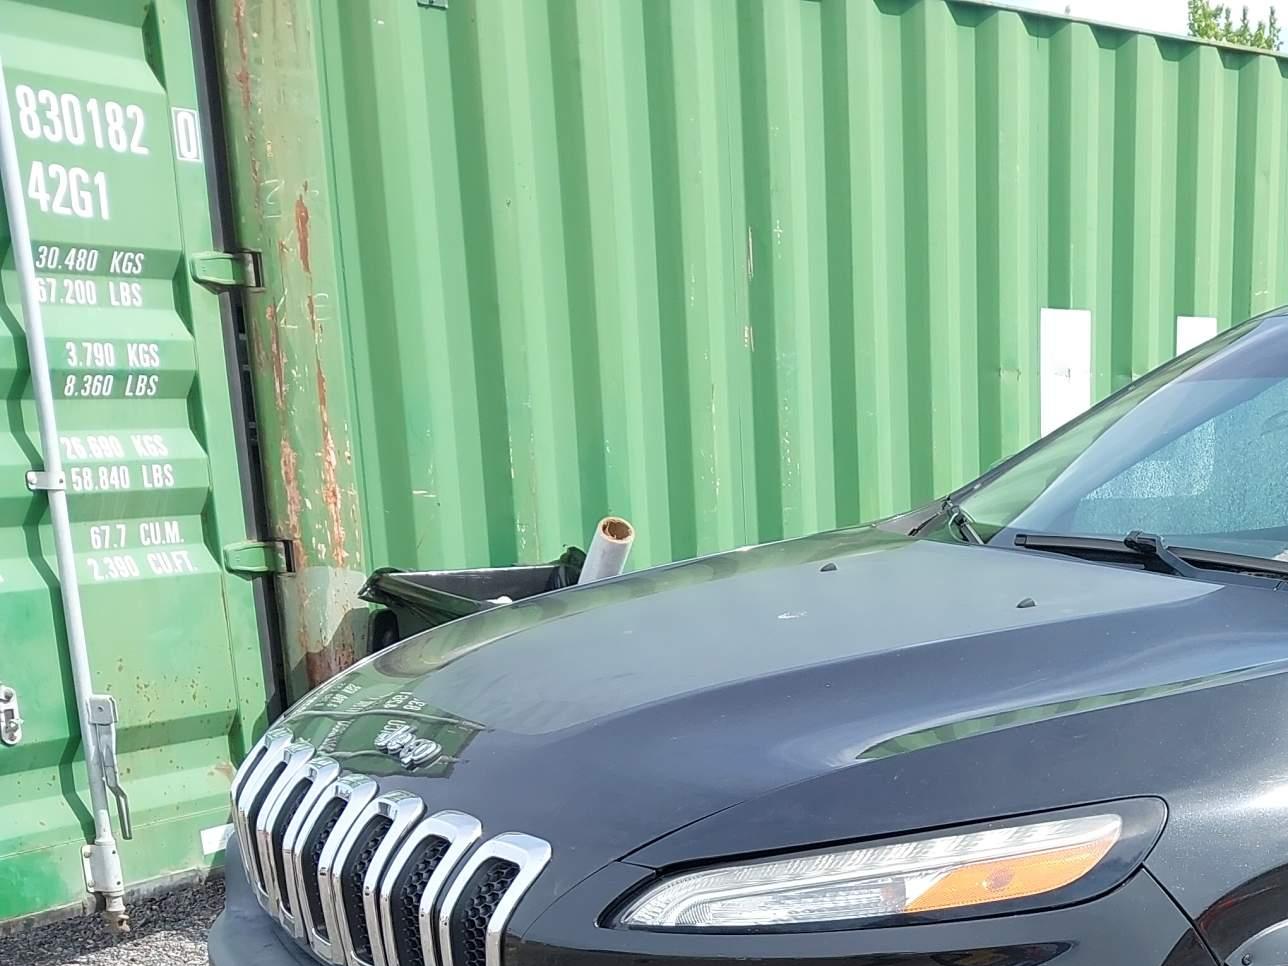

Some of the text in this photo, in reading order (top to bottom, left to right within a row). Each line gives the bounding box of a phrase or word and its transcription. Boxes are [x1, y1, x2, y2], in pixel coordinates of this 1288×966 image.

[16, 85, 198, 159] 830182 0
[28, 160, 110, 220] 42G1
[35, 245, 145, 274] 30.480 KGS
[35, 277, 143, 307] 67.200 LBS
[65, 341, 160, 368] 3.790 KGS
[64, 374, 158, 396] 8.360 LBS
[130, 434, 168, 457] KGS
[71, 463, 174, 491] 58.840 LBS
[90, 520, 185, 549] 67.7 CU.M.
[86, 555, 139, 580] 2.390
[374, 724, 442, 770] Jeep
